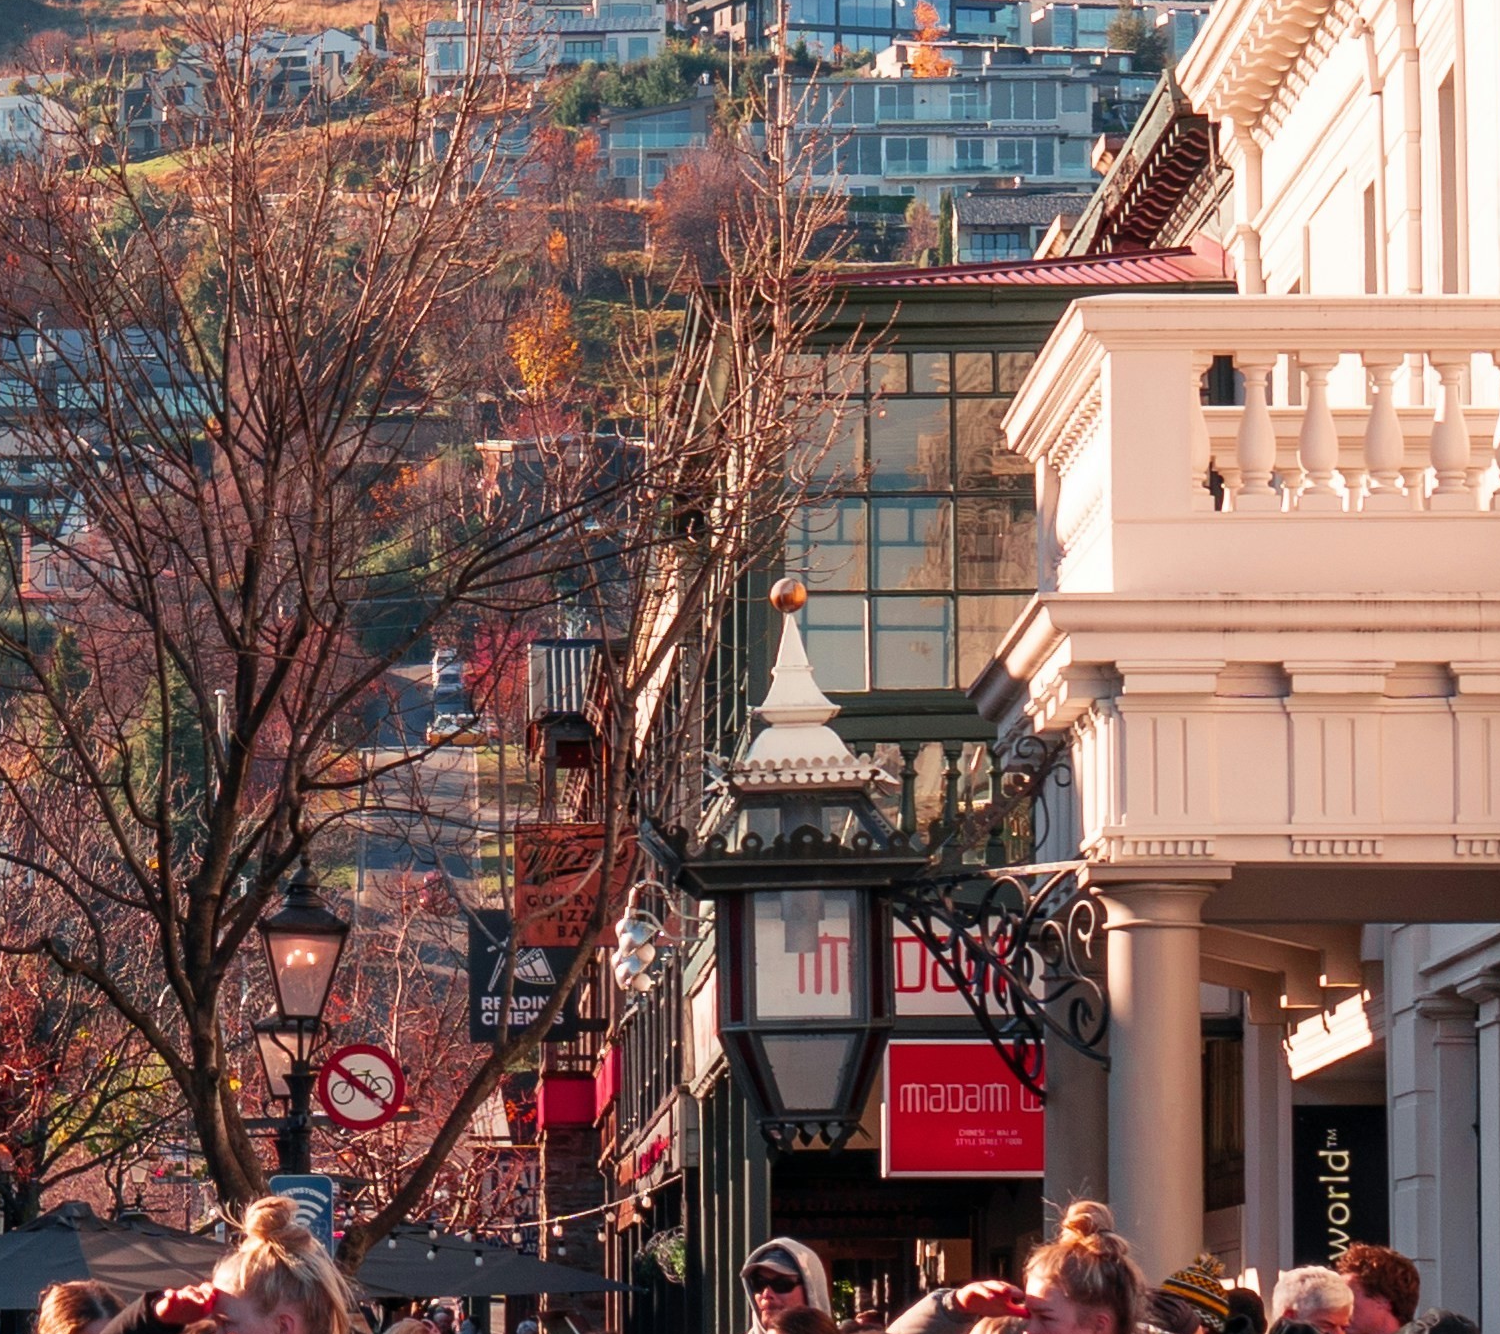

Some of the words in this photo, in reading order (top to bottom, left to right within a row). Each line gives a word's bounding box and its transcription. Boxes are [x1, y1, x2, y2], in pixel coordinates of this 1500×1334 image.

[546, 911, 593, 924] PIZZ
[557, 926, 581, 938] BA
[481, 996, 550, 1011] READIN
[481, 1011, 565, 1026] CIEMS
